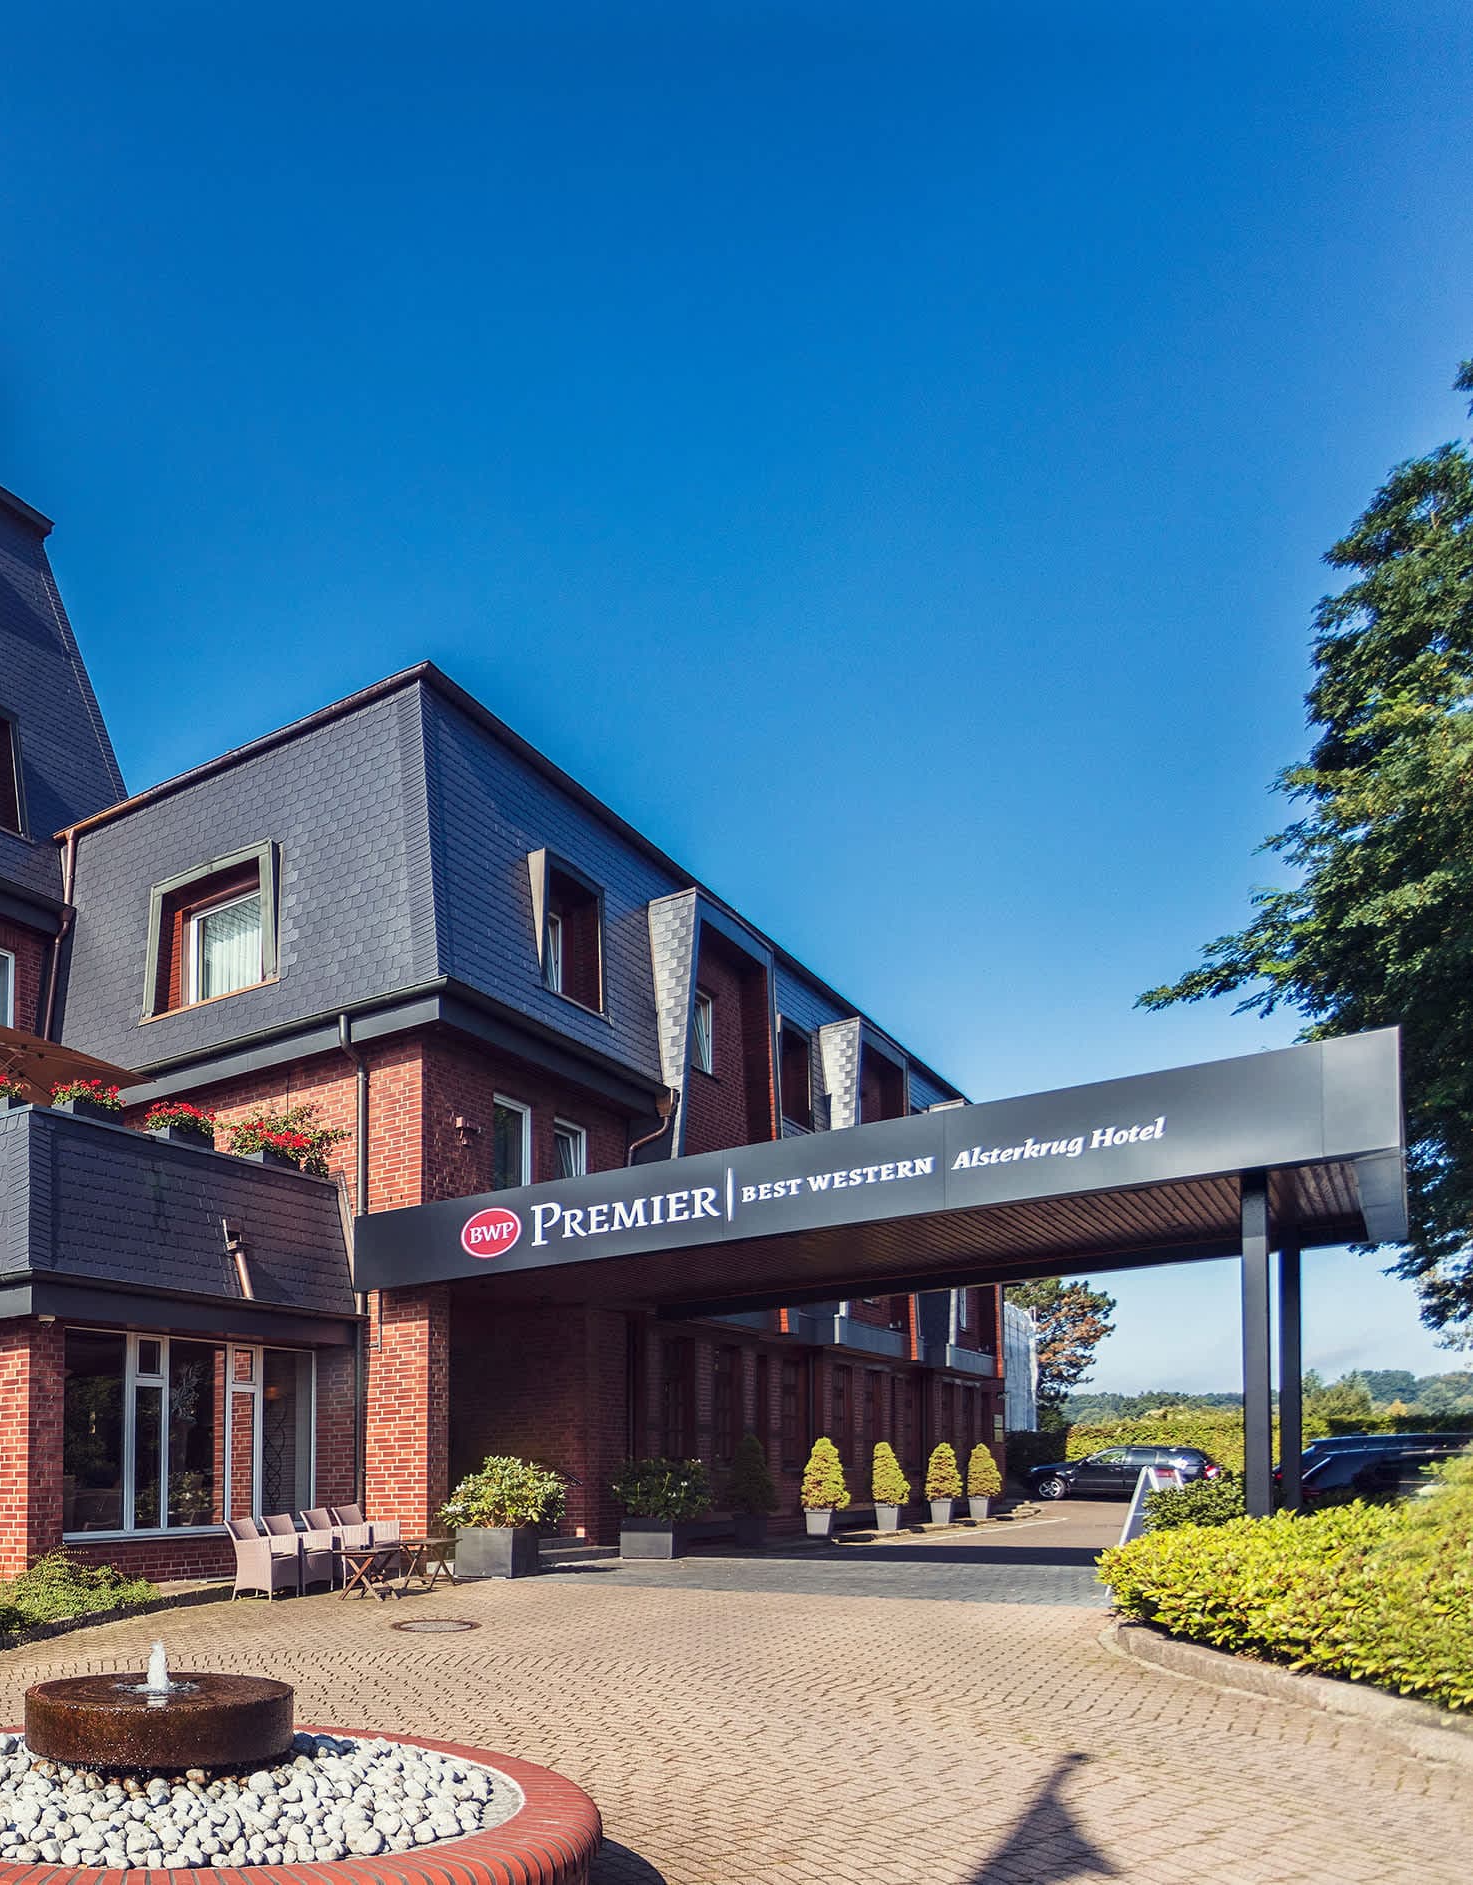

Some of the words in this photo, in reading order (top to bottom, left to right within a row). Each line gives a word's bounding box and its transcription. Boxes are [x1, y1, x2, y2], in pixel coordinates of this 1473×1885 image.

[469, 1221, 515, 1245] BWP
[530, 1187, 722, 1247] PREMIER
[741, 1178, 803, 1203] BEST
[806, 1156, 936, 1192] WESTERN
[950, 1135, 1087, 1171] Alsterkrug
[1089, 1115, 1168, 1150] Hotel
